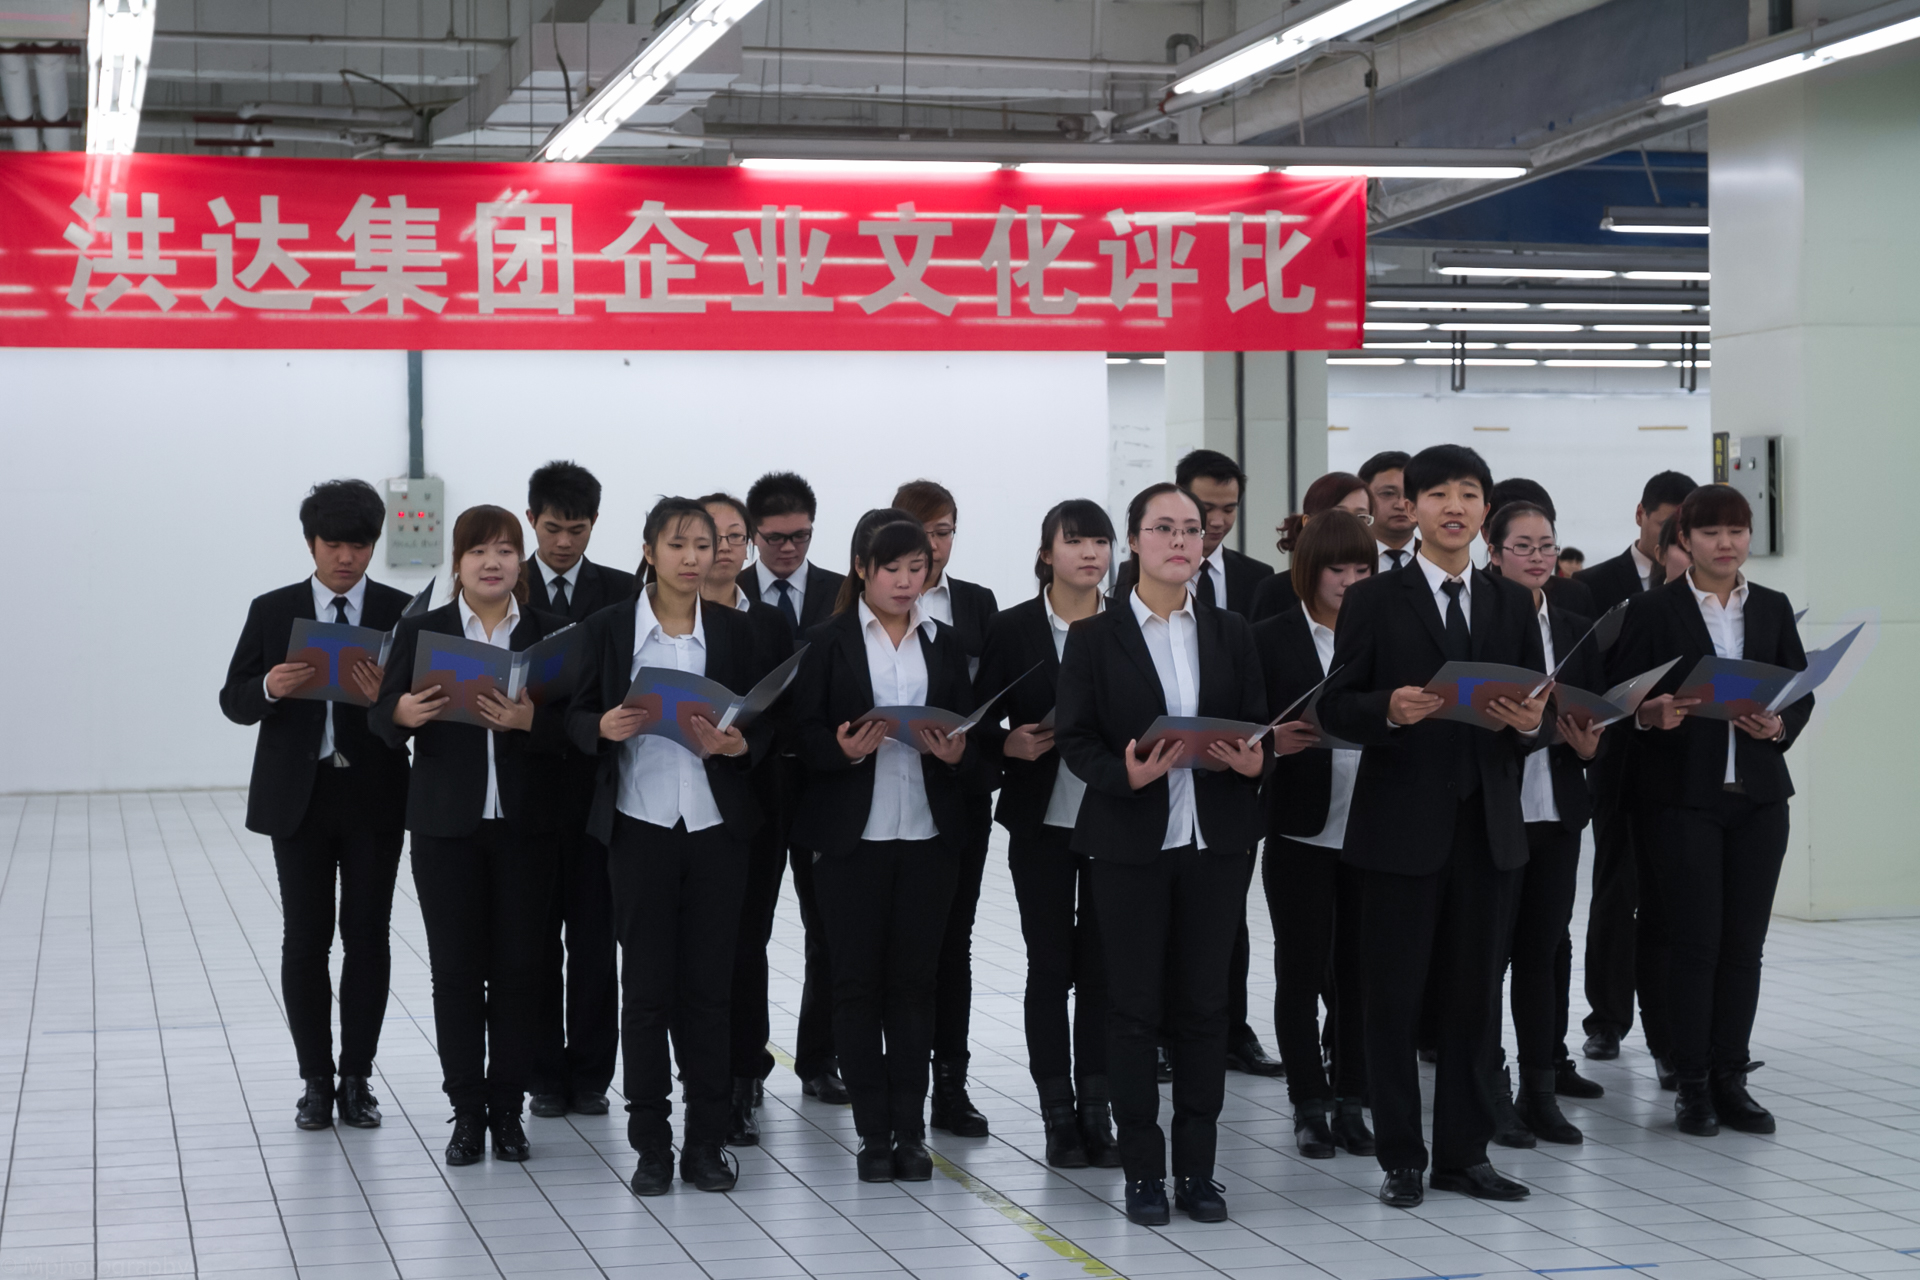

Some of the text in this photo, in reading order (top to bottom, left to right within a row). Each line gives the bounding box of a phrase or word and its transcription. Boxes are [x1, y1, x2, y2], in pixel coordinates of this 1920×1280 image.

[62, 192, 1316, 317] 洪达集团企业文化评比
